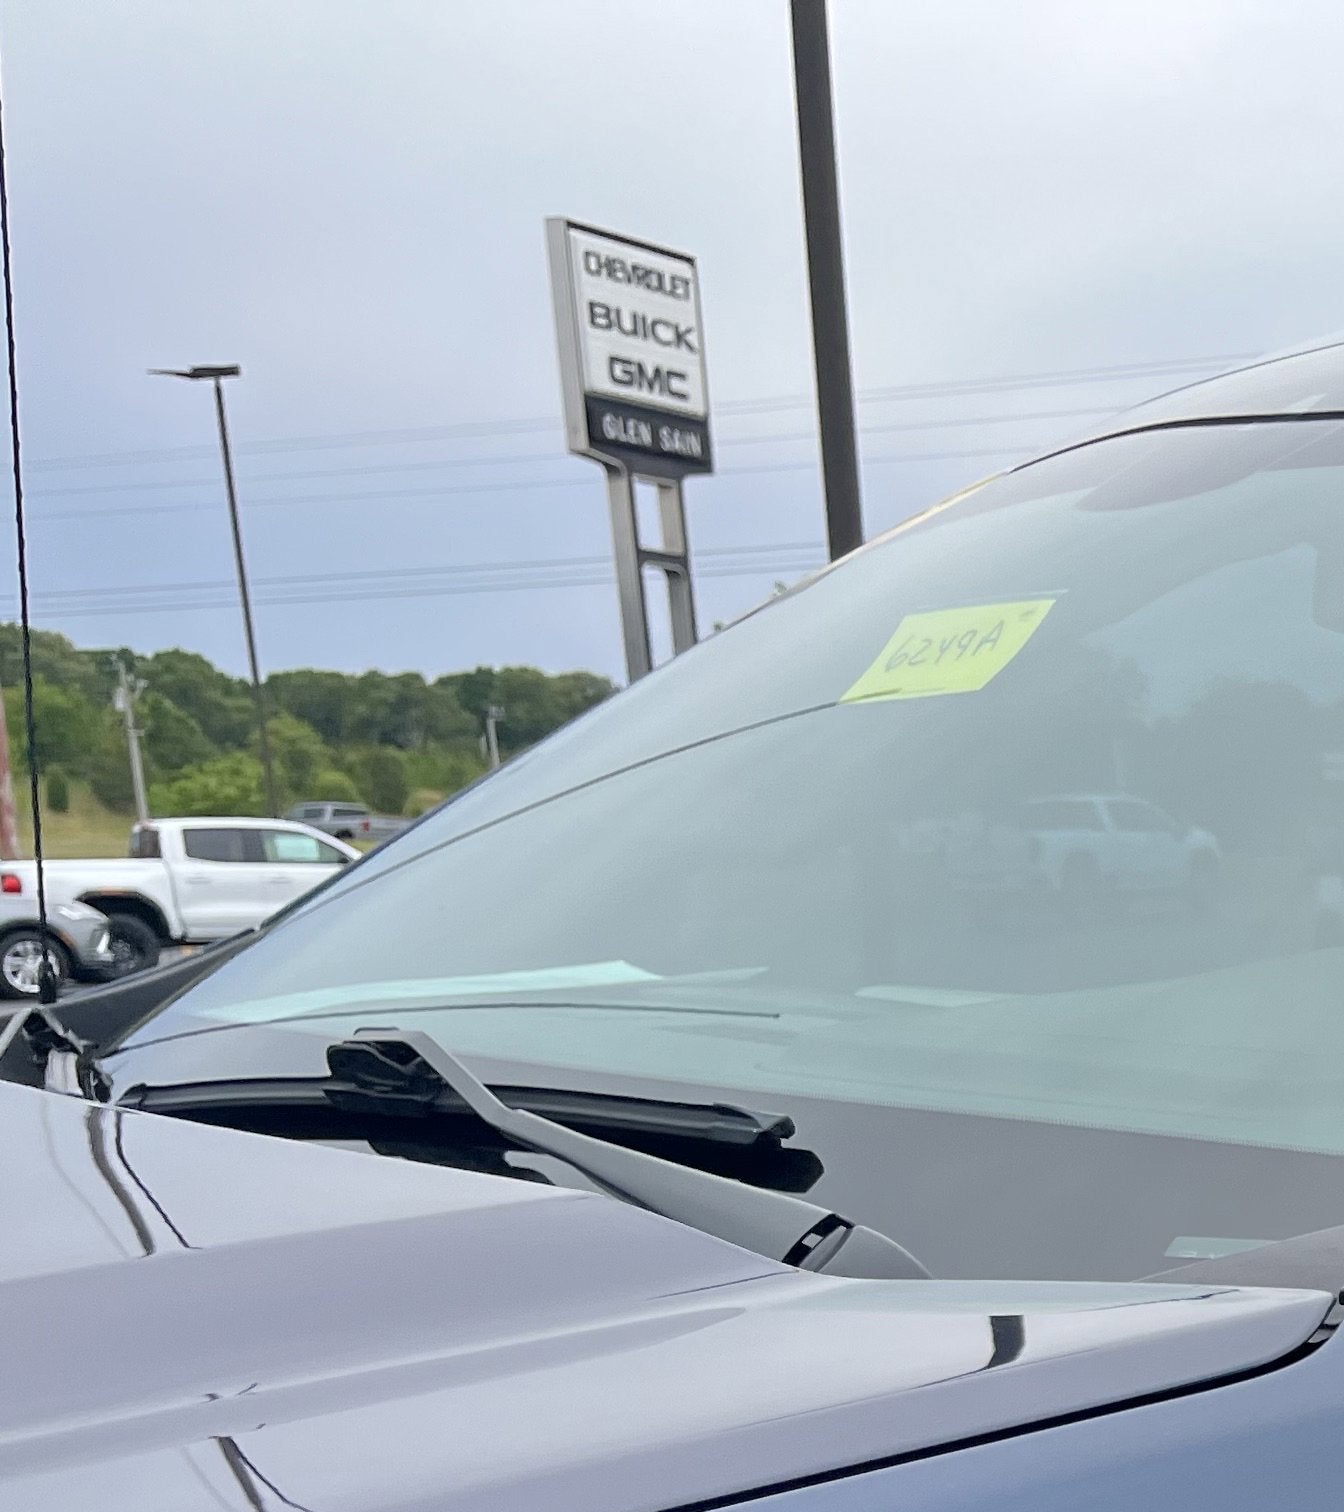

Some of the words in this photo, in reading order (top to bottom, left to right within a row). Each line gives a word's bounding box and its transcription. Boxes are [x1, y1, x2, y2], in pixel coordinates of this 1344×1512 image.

[589, 301, 698, 353] BUICK
[609, 356, 688, 400] GMC
[602, 412, 652, 448] GLEN
